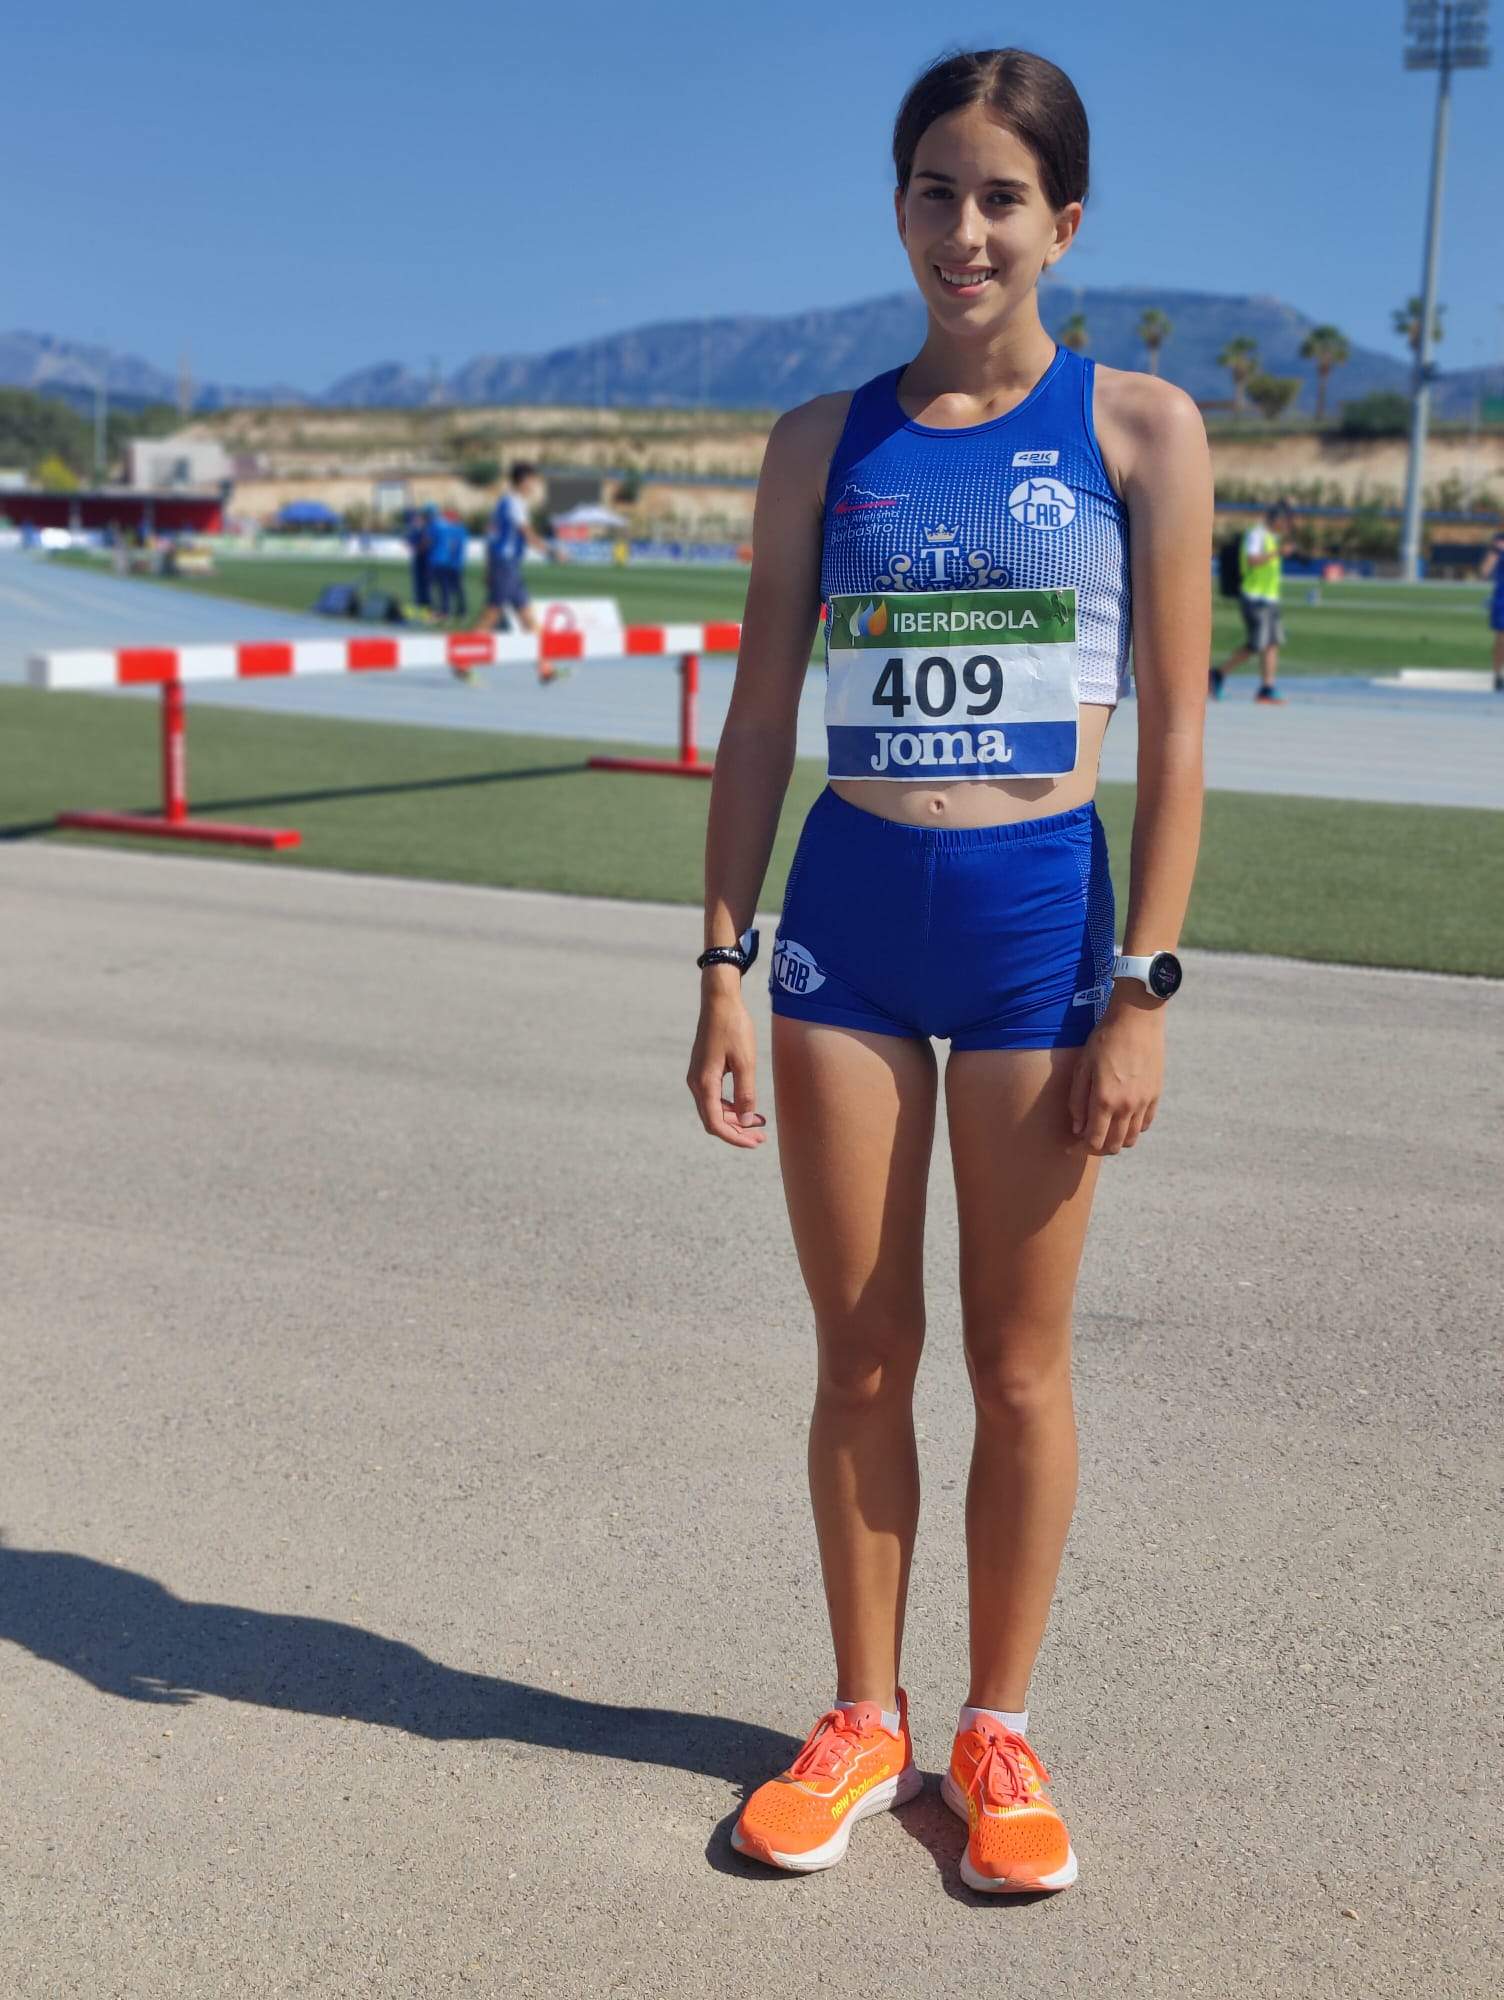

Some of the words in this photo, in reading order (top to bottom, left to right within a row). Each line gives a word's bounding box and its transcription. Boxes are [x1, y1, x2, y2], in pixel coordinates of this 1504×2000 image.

[1023, 502, 1061, 527] CAB
[921, 547, 960, 581] T
[893, 609, 1039, 633] IBERDROLA
[872, 654, 1004, 718] 409
[777, 953, 810, 992] CAB
[832, 1794, 849, 1820] new
